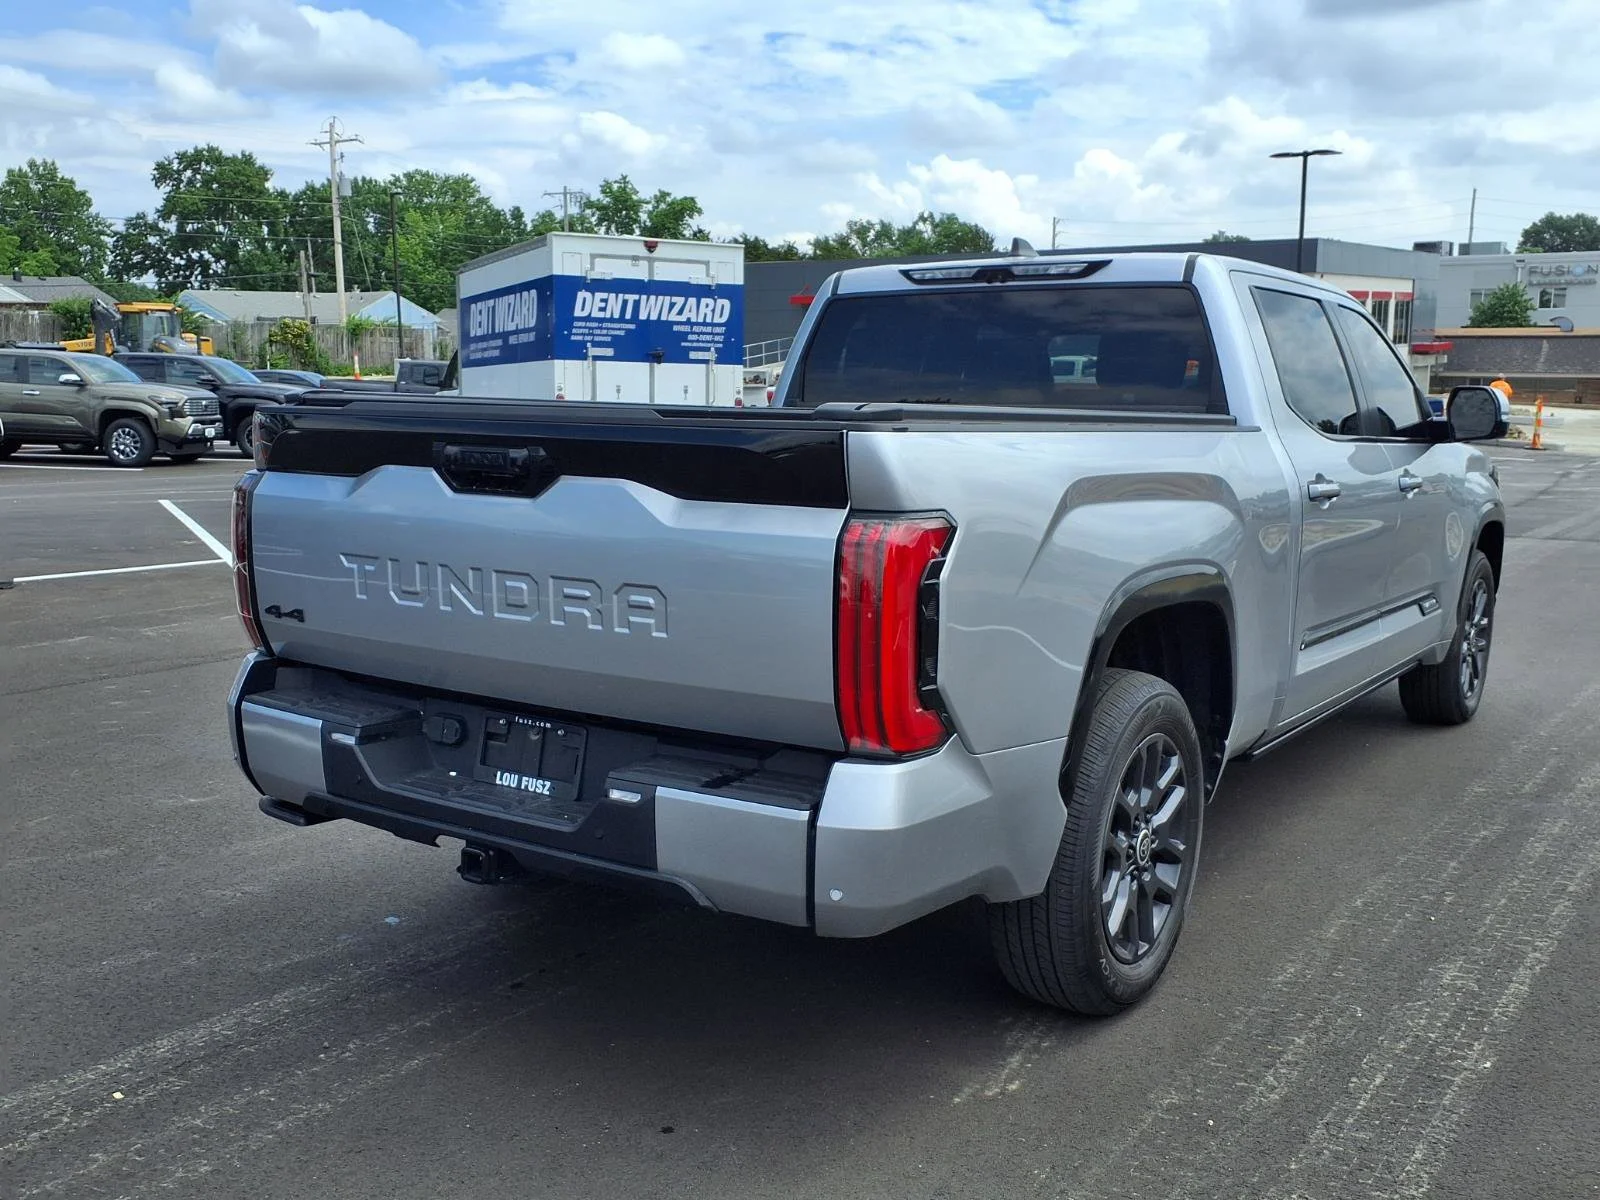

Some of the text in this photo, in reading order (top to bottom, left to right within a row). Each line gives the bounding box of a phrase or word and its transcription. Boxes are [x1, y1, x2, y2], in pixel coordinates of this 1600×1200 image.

[1528, 264, 1599, 277] FUSION
[470, 289, 538, 337] DENT WIZARD
[574, 291, 730, 324] DENT WIZARD
[692, 325, 712, 333] REPAIR
[339, 551, 669, 639] TUNDRA
[515, 715, 552, 729] fusz.com
[495, 770, 552, 796] LOU FUSZ
